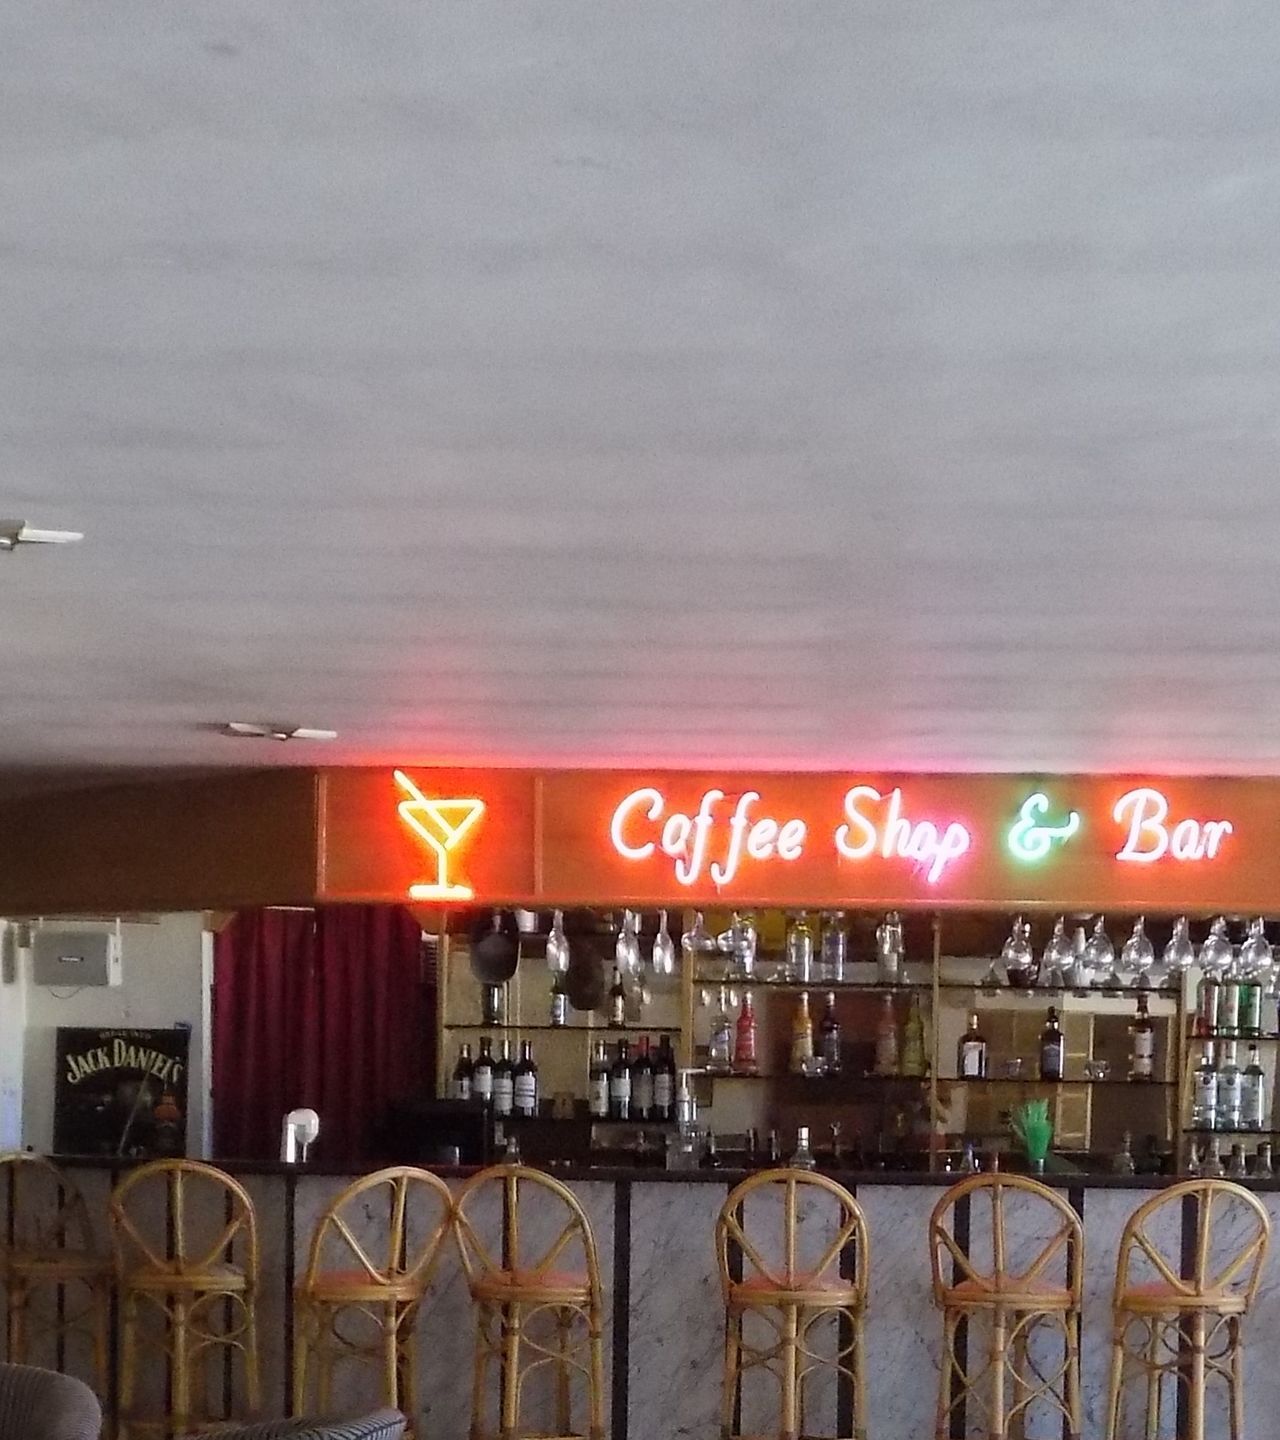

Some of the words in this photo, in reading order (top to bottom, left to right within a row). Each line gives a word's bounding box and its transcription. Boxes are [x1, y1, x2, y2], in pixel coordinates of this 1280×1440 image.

[610, 786, 807, 885] Coffee
[835, 784, 971, 883] Shop
[1007, 793, 1080, 861] &
[1112, 787, 1233, 862] Bar
[66, 1046, 111, 1083] JACK
